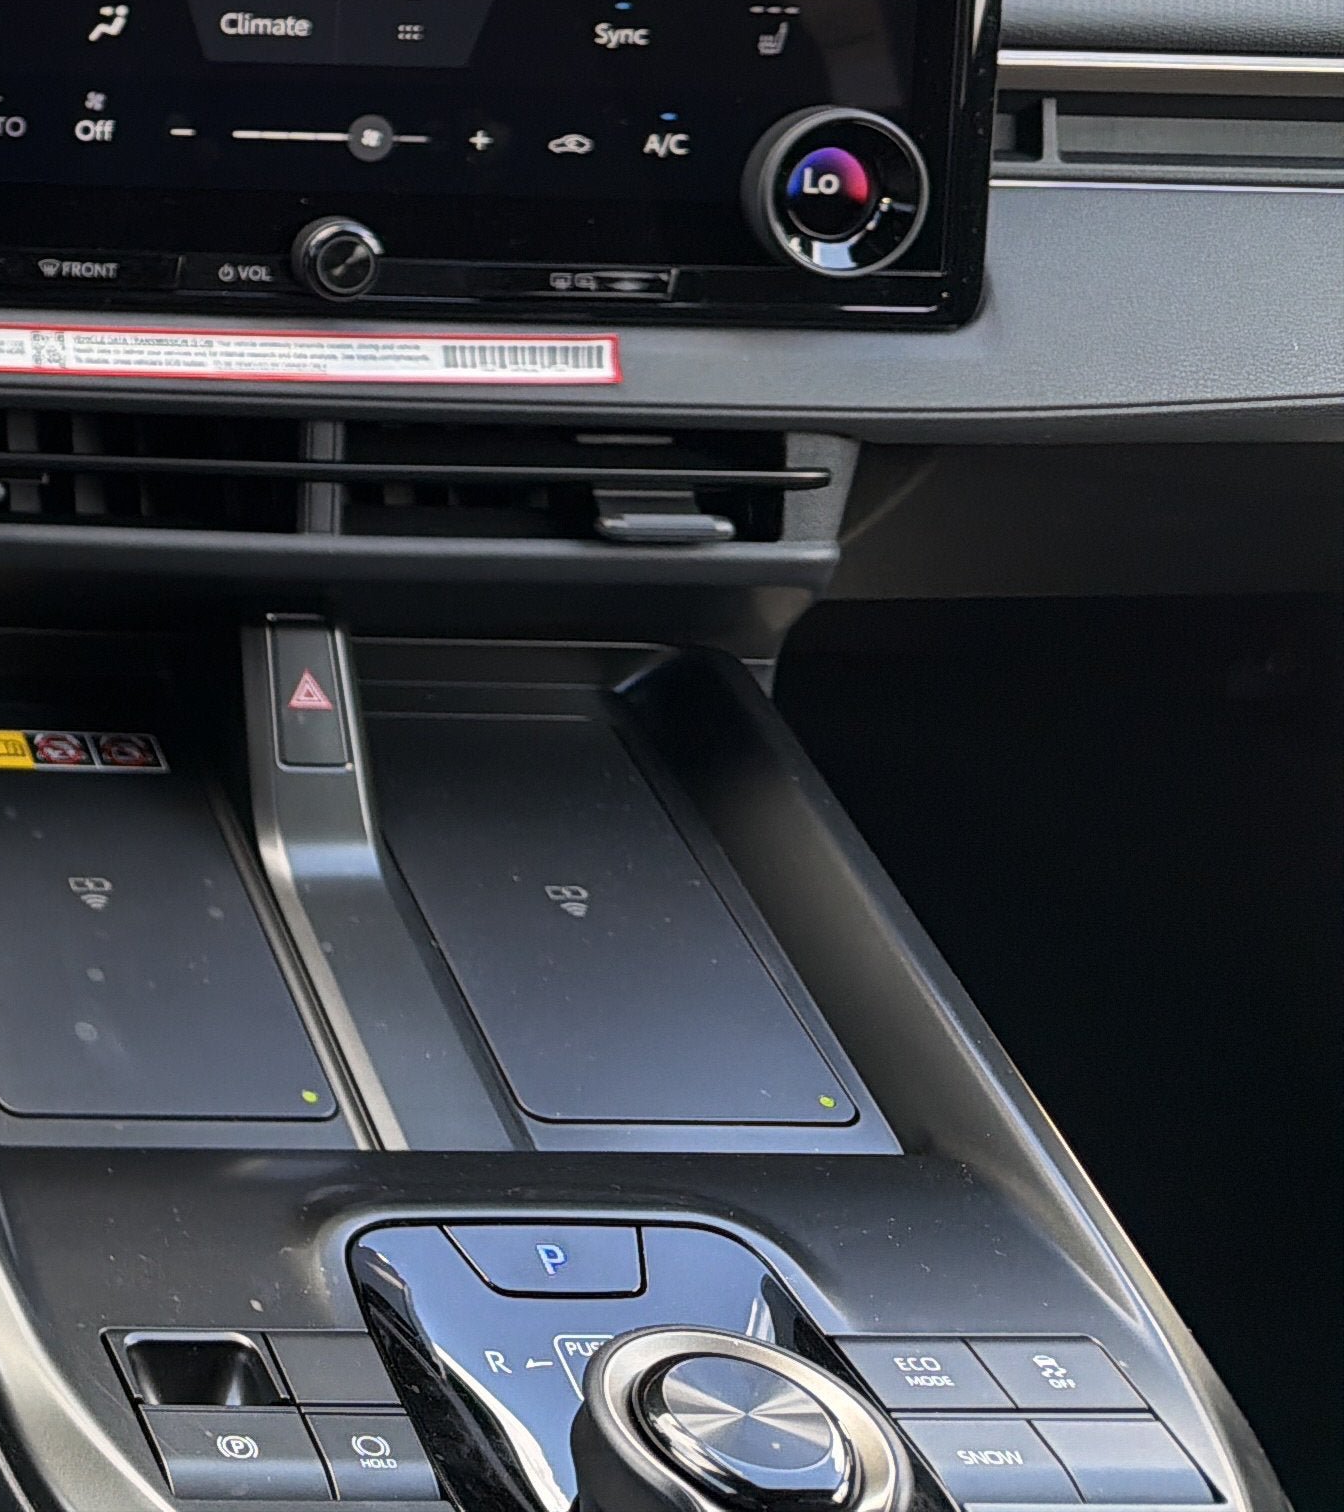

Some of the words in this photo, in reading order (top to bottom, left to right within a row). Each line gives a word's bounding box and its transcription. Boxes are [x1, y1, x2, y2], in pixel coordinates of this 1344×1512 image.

[219, 12, 313, 38] Climate
[593, 22, 652, 51] Sync
[74, 119, 115, 143] Off
[643, 134, 691, 158] A/C
[801, 168, 840, 196] Lo
[61, 261, 118, 280] FRONT
[237, 265, 273, 282] VOL
[535, 1242, 568, 1276] P
[564, 1340, 605, 1357] PUS
[484, 1349, 513, 1374] R
[893, 1356, 941, 1372] ECO
[905, 1374, 956, 1388] MODE
[1049, 1378, 1077, 1390] OFF
[360, 1457, 398, 1470] HOLD
[957, 1449, 1024, 1467] SNOW
